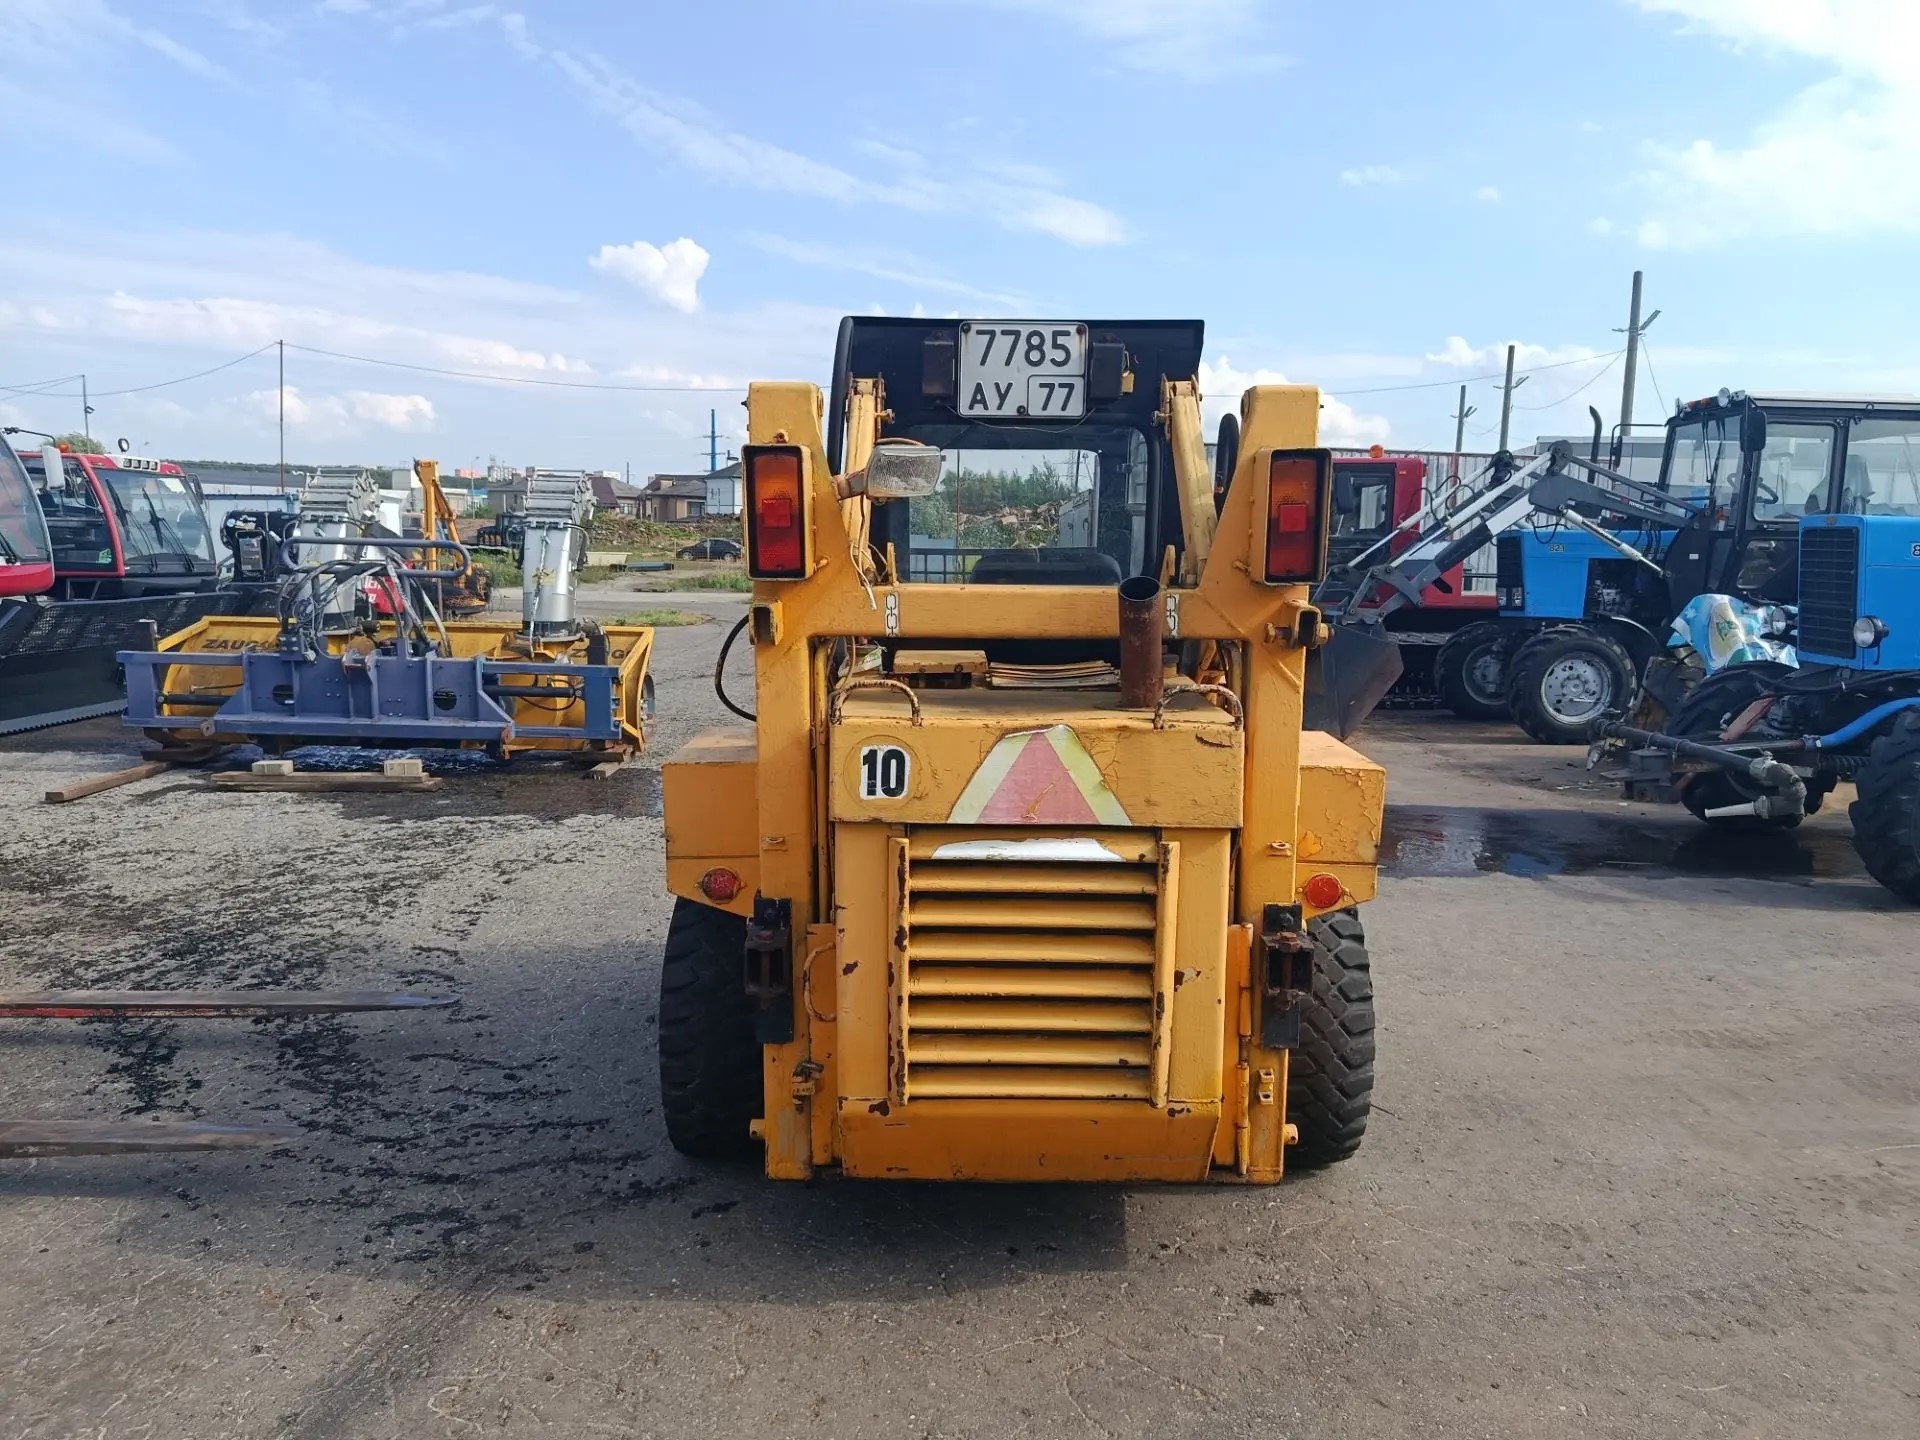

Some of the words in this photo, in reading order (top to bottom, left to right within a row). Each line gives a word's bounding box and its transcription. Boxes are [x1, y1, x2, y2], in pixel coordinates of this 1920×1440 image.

[976, 329, 1071, 367] 7785
[968, 382, 1013, 411] АУ
[1039, 383, 1075, 411] 77
[862, 749, 906, 798] 10
